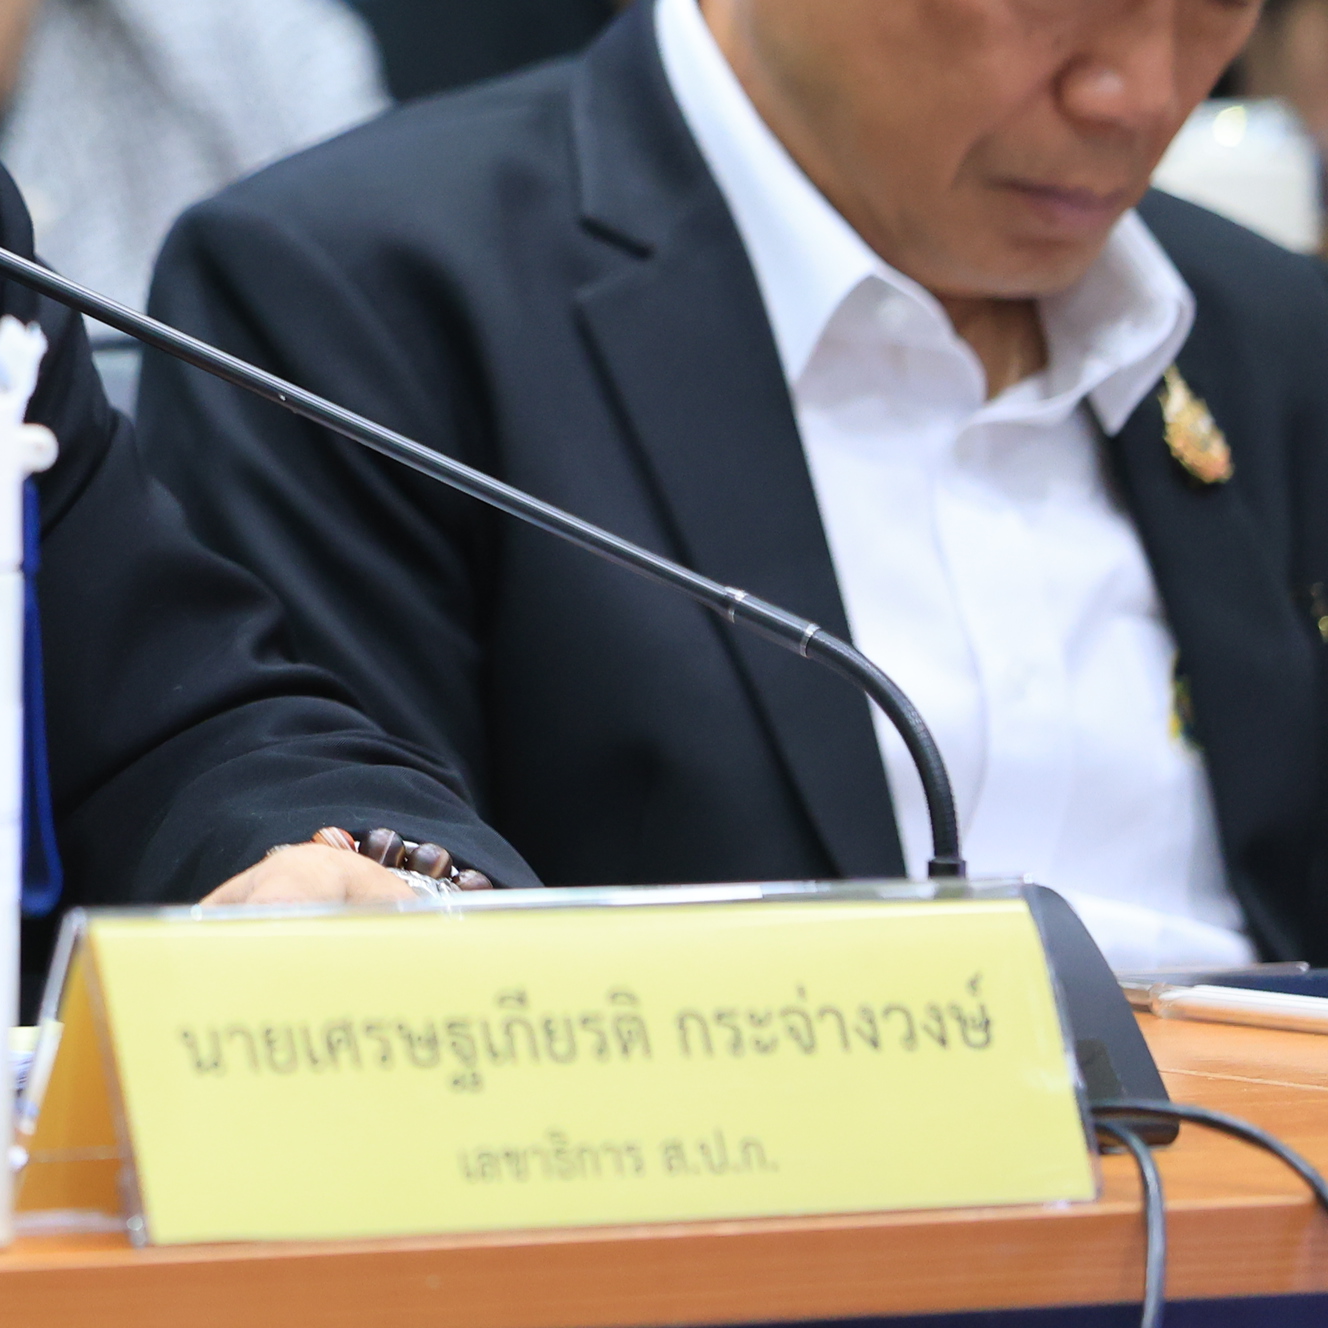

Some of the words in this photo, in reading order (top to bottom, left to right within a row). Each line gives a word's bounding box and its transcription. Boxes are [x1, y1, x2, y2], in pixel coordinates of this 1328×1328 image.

[177, 986, 653, 1094] นายเศรษฐเกียรติ
[673, 970, 994, 1059] กระจ่างวงษ์
